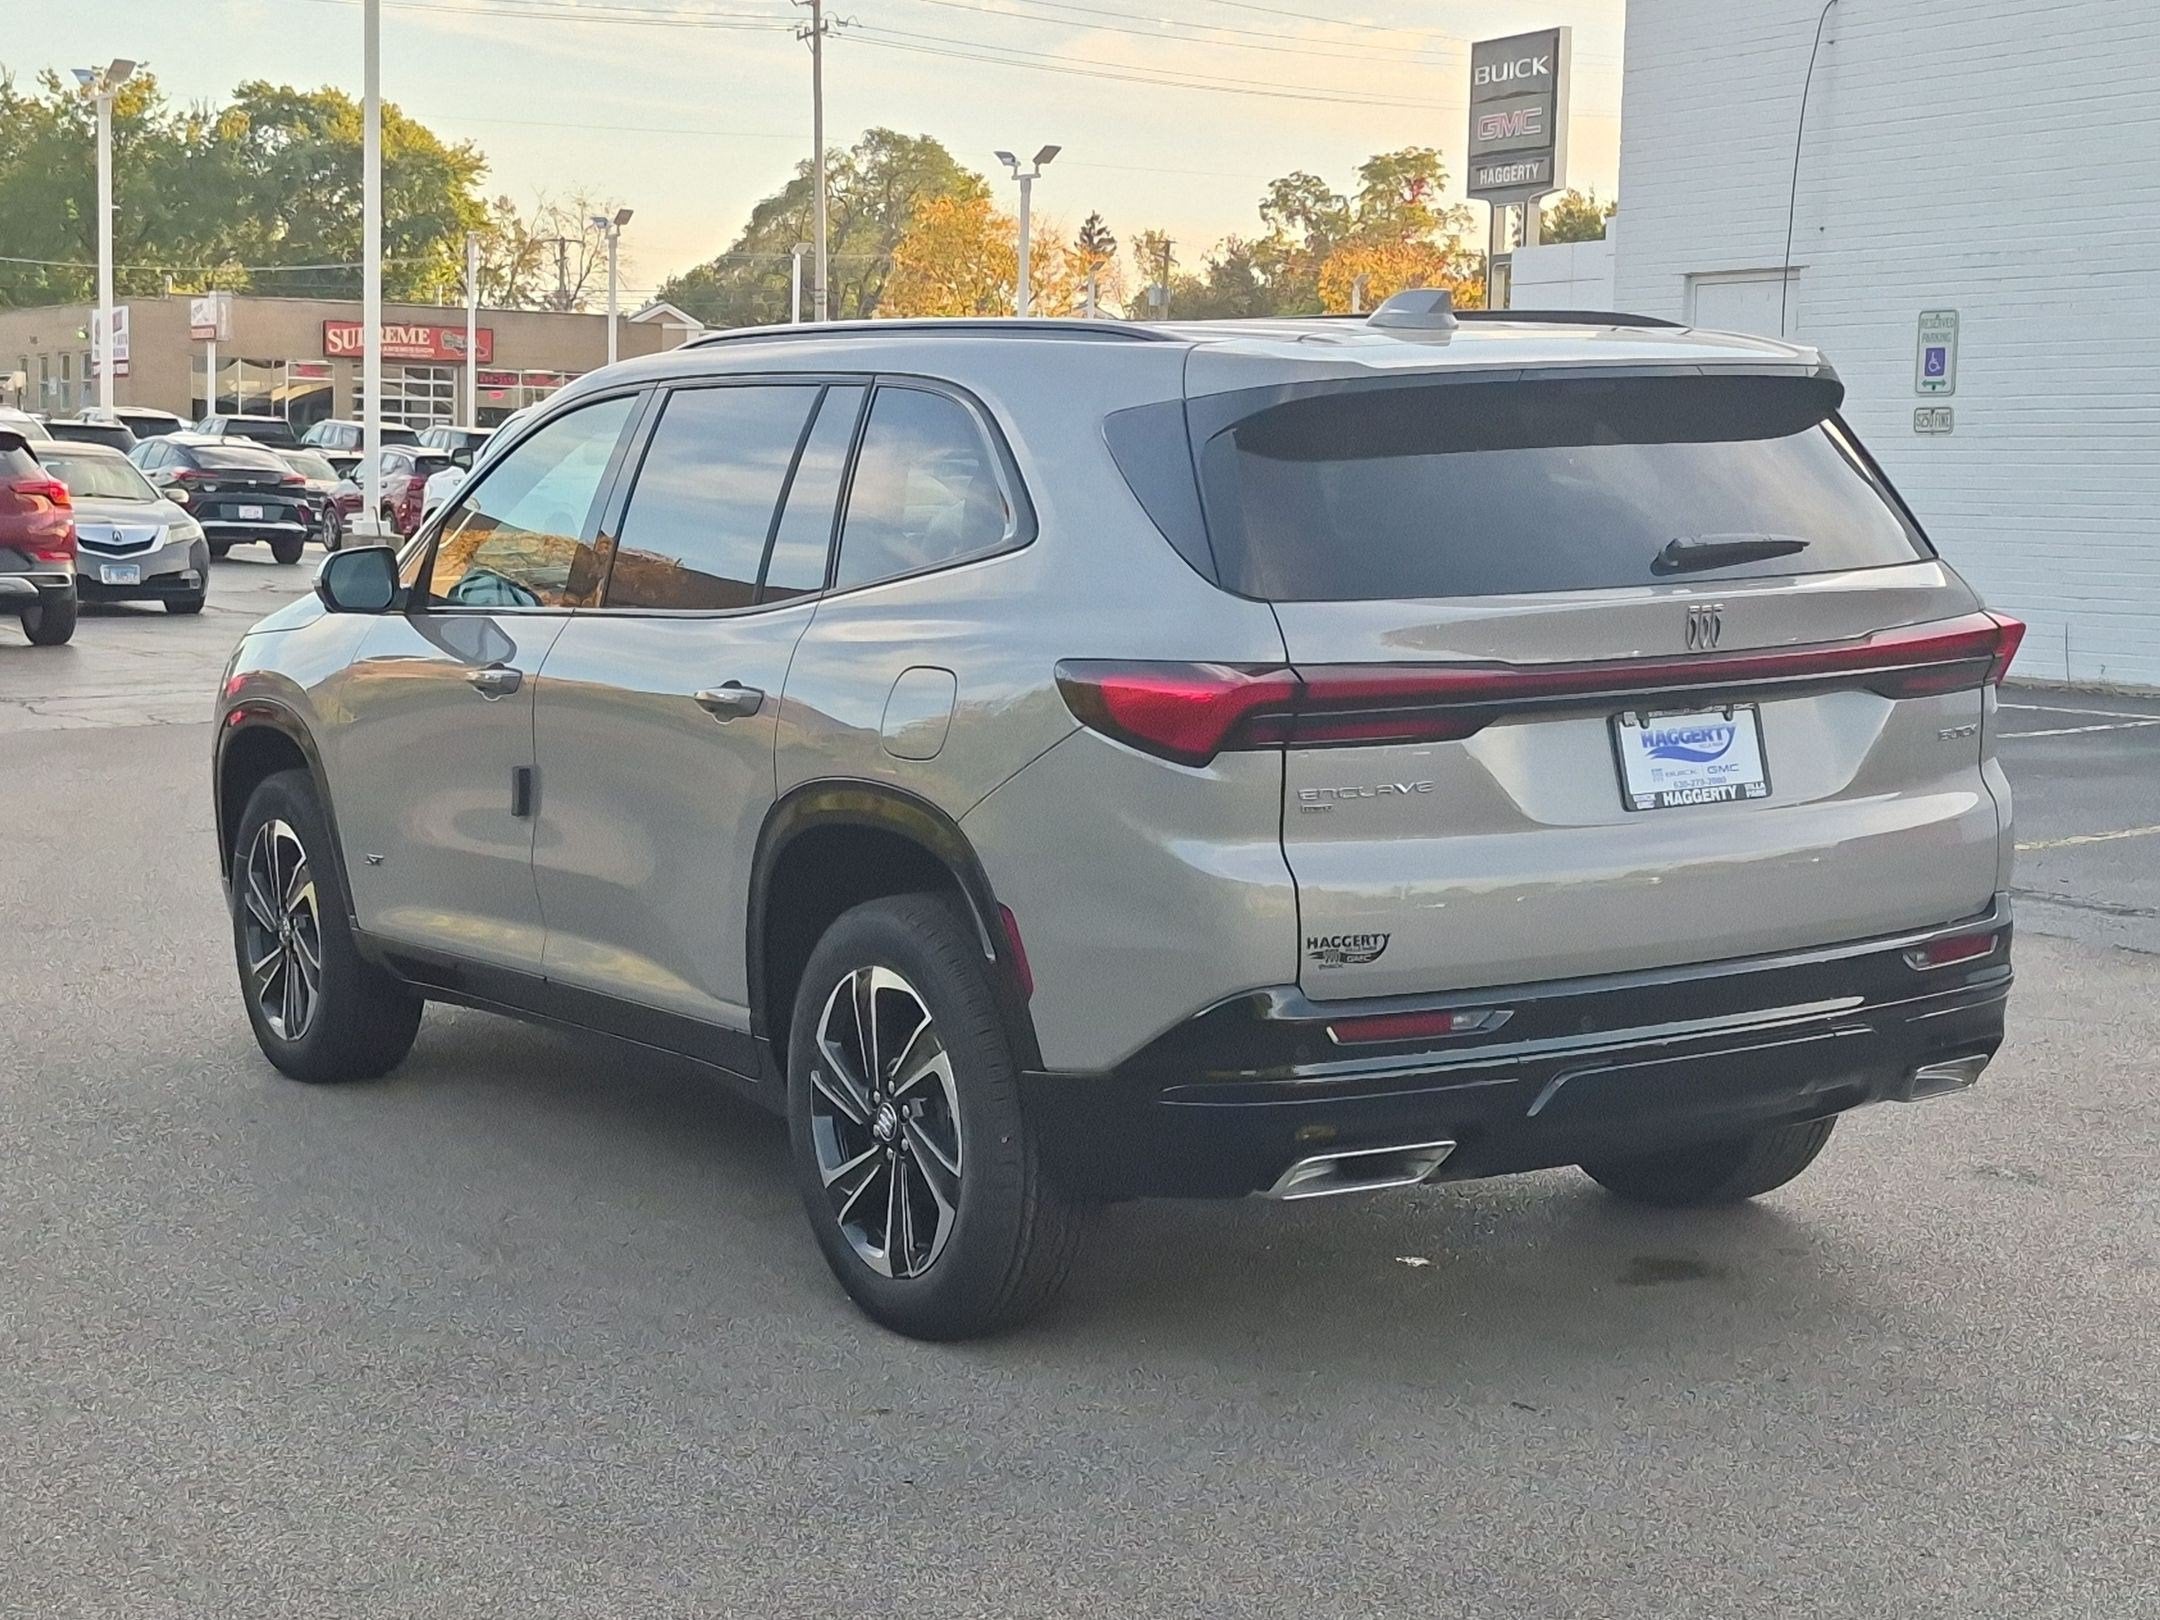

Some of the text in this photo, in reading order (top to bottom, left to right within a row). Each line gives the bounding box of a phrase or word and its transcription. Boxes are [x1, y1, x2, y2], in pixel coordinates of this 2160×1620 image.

[1474, 55, 1549, 86] BUICK
[1478, 106, 1543, 141] GMC
[1479, 162, 1540, 185] HAGGERTY
[1640, 722, 1737, 749] HAGGERTY
[1706, 763, 1740, 775] GMC
[1298, 780, 1435, 801] ENCLAVE
[1662, 785, 1738, 807] HAGGERTY
[1306, 932, 1391, 950] HAGGERTY
